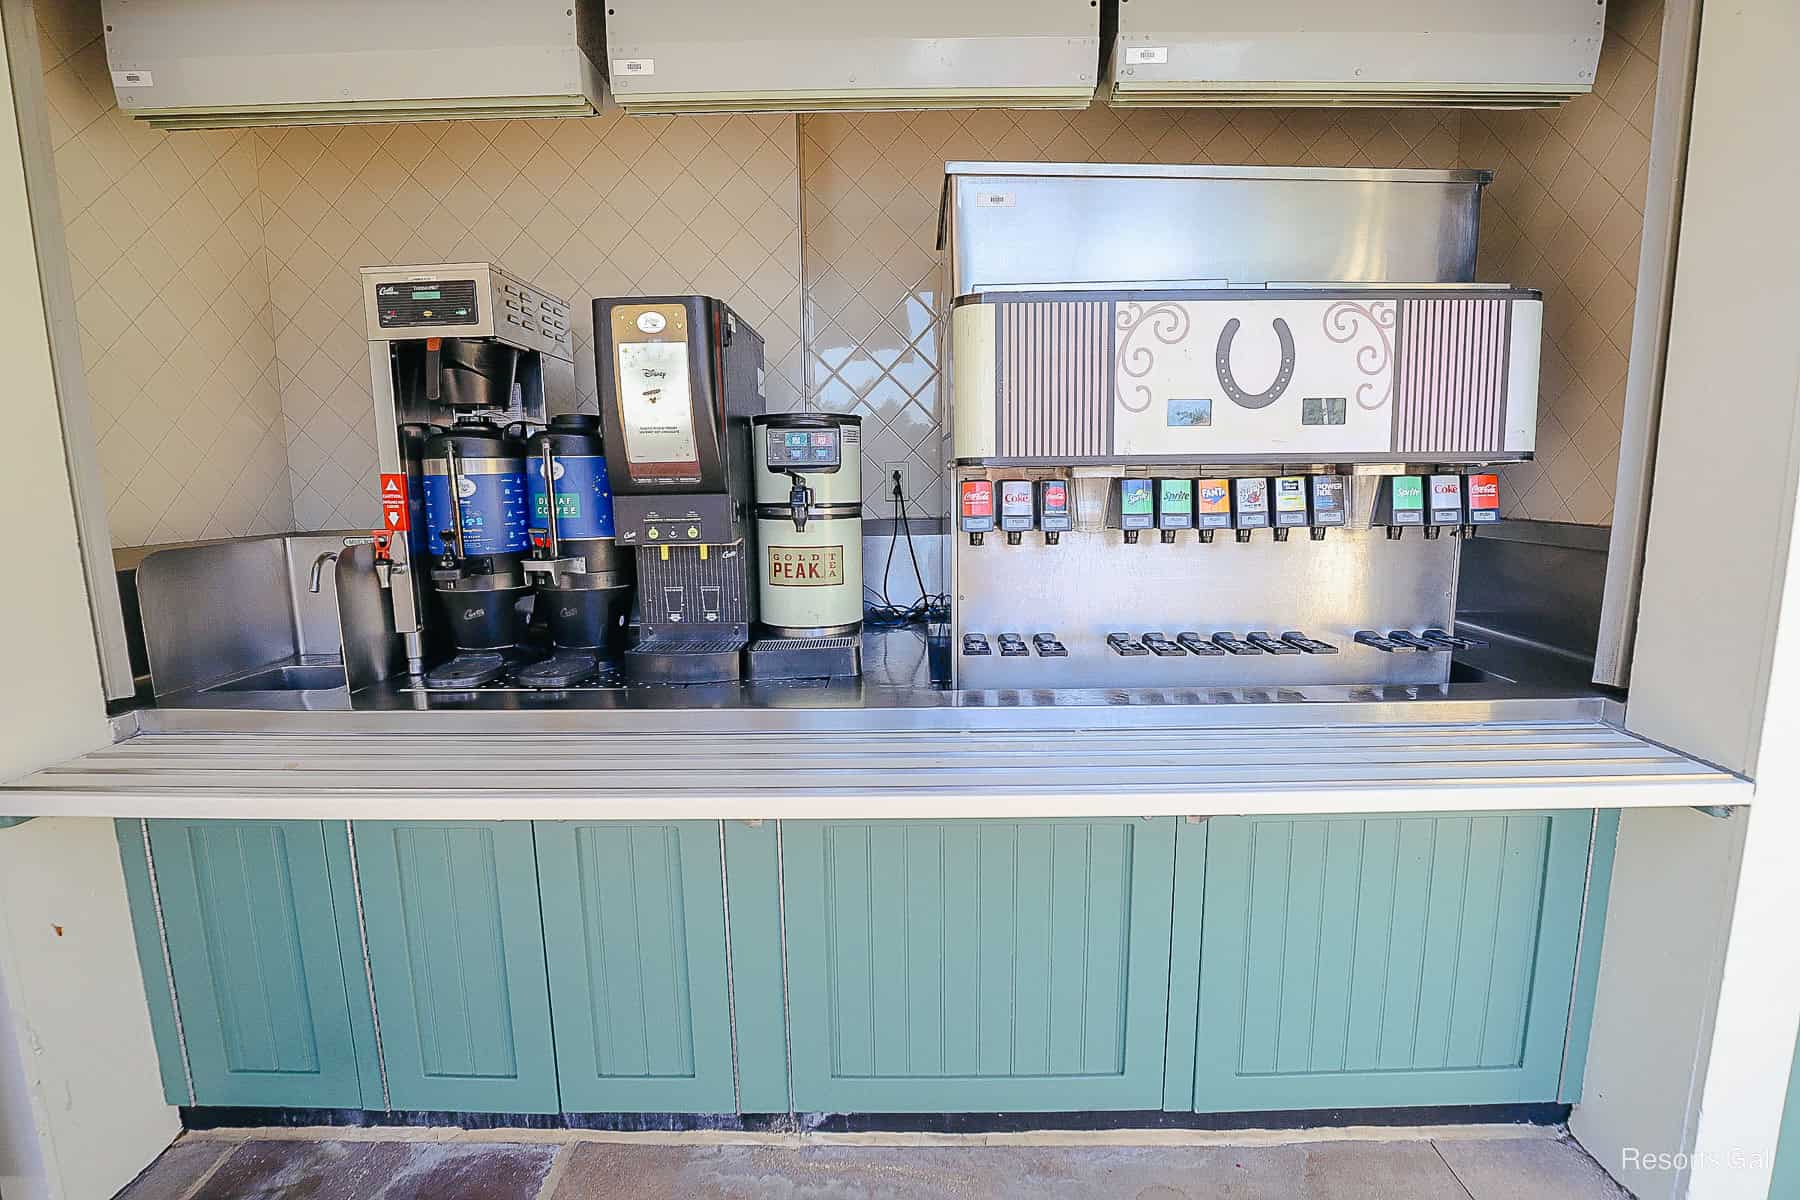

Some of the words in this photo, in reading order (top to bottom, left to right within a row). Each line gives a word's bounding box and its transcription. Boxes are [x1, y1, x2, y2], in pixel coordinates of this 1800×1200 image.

[641, 368, 667, 380] Disney
[1316, 482, 1343, 490] POWER
[1434, 484, 1458, 495] Coke
[1004, 492, 1029, 503] Coke
[1164, 490, 1190, 502] Sprite
[772, 553, 820, 561] GOLD
[773, 562, 820, 579] PEAK
[829, 553, 837, 577] TEA
